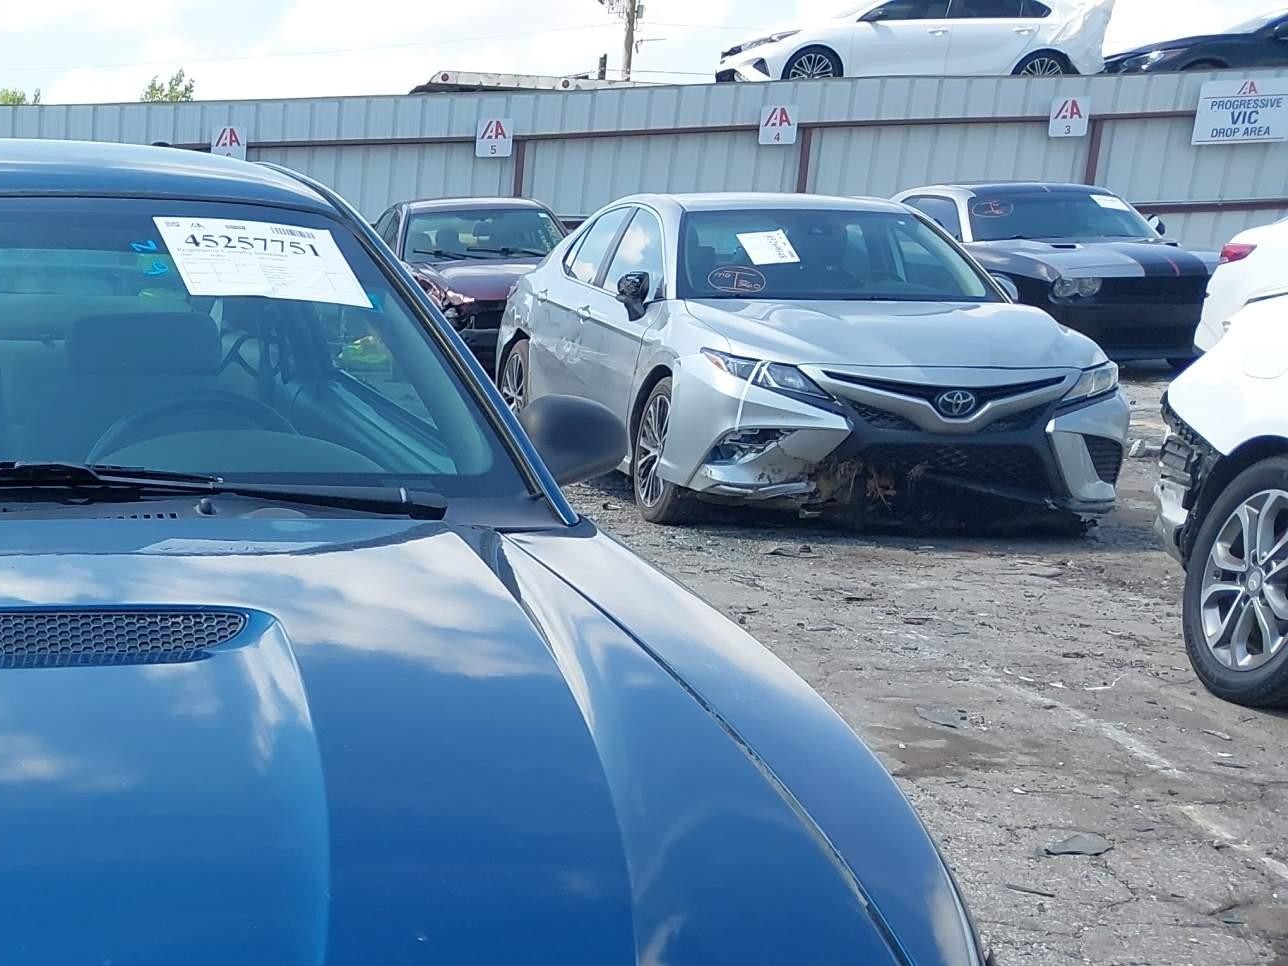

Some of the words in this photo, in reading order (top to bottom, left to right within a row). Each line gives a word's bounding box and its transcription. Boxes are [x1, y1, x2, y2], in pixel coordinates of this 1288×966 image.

[1210, 97, 1283, 110] PROGRESSIVE
[1230, 110, 1259, 125] VIC
[1064, 125, 1072, 135] 3
[1210, 127, 1240, 138] DROP
[1242, 126, 1271, 137] AREA
[773, 132, 782, 142] 4
[490, 145, 498, 155] 5
[184, 233, 322, 257] 45257751
